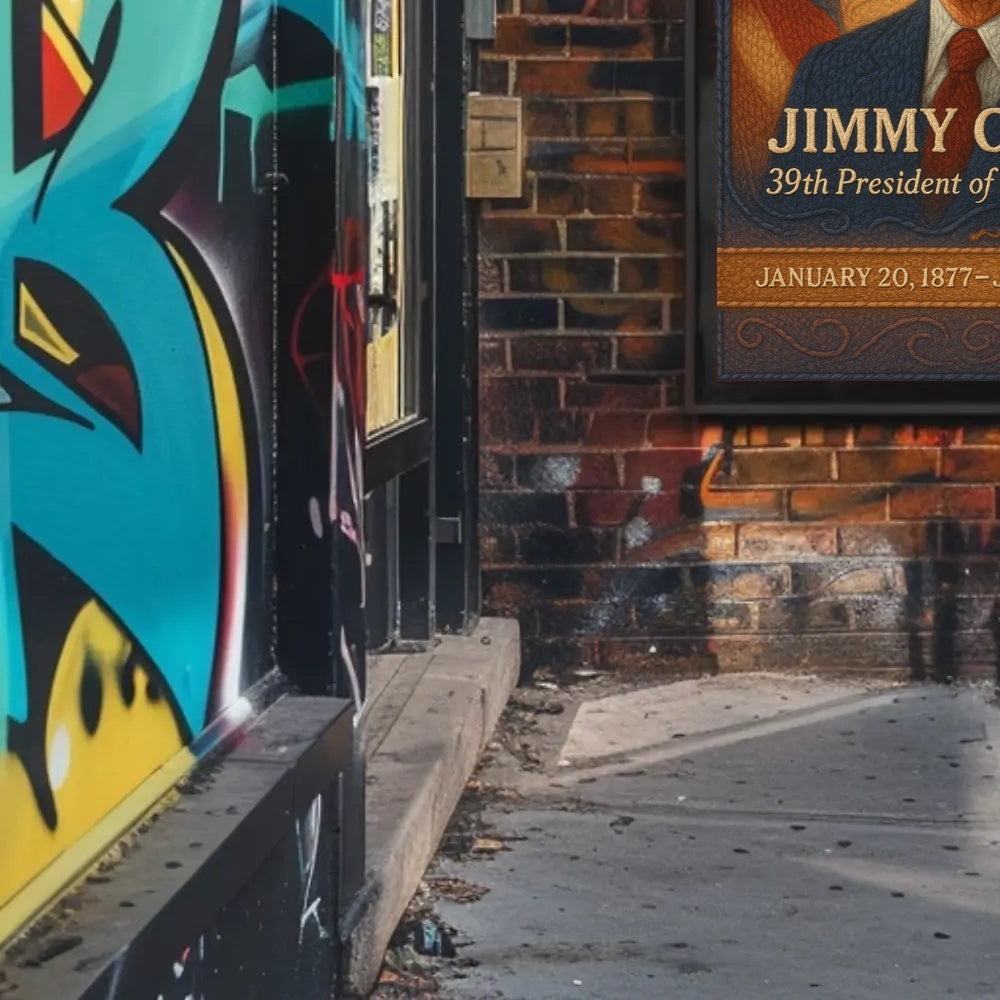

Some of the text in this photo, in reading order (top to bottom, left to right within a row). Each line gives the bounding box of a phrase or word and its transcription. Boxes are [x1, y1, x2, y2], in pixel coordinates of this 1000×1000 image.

[767, 107, 958, 153] JIMMY
[766, 167, 829, 195] 39th
[835, 168, 963, 195] President
[968, 166, 999, 204] of
[755, 266, 872, 288] JANUARY
[877, 267, 915, 292] 20,
